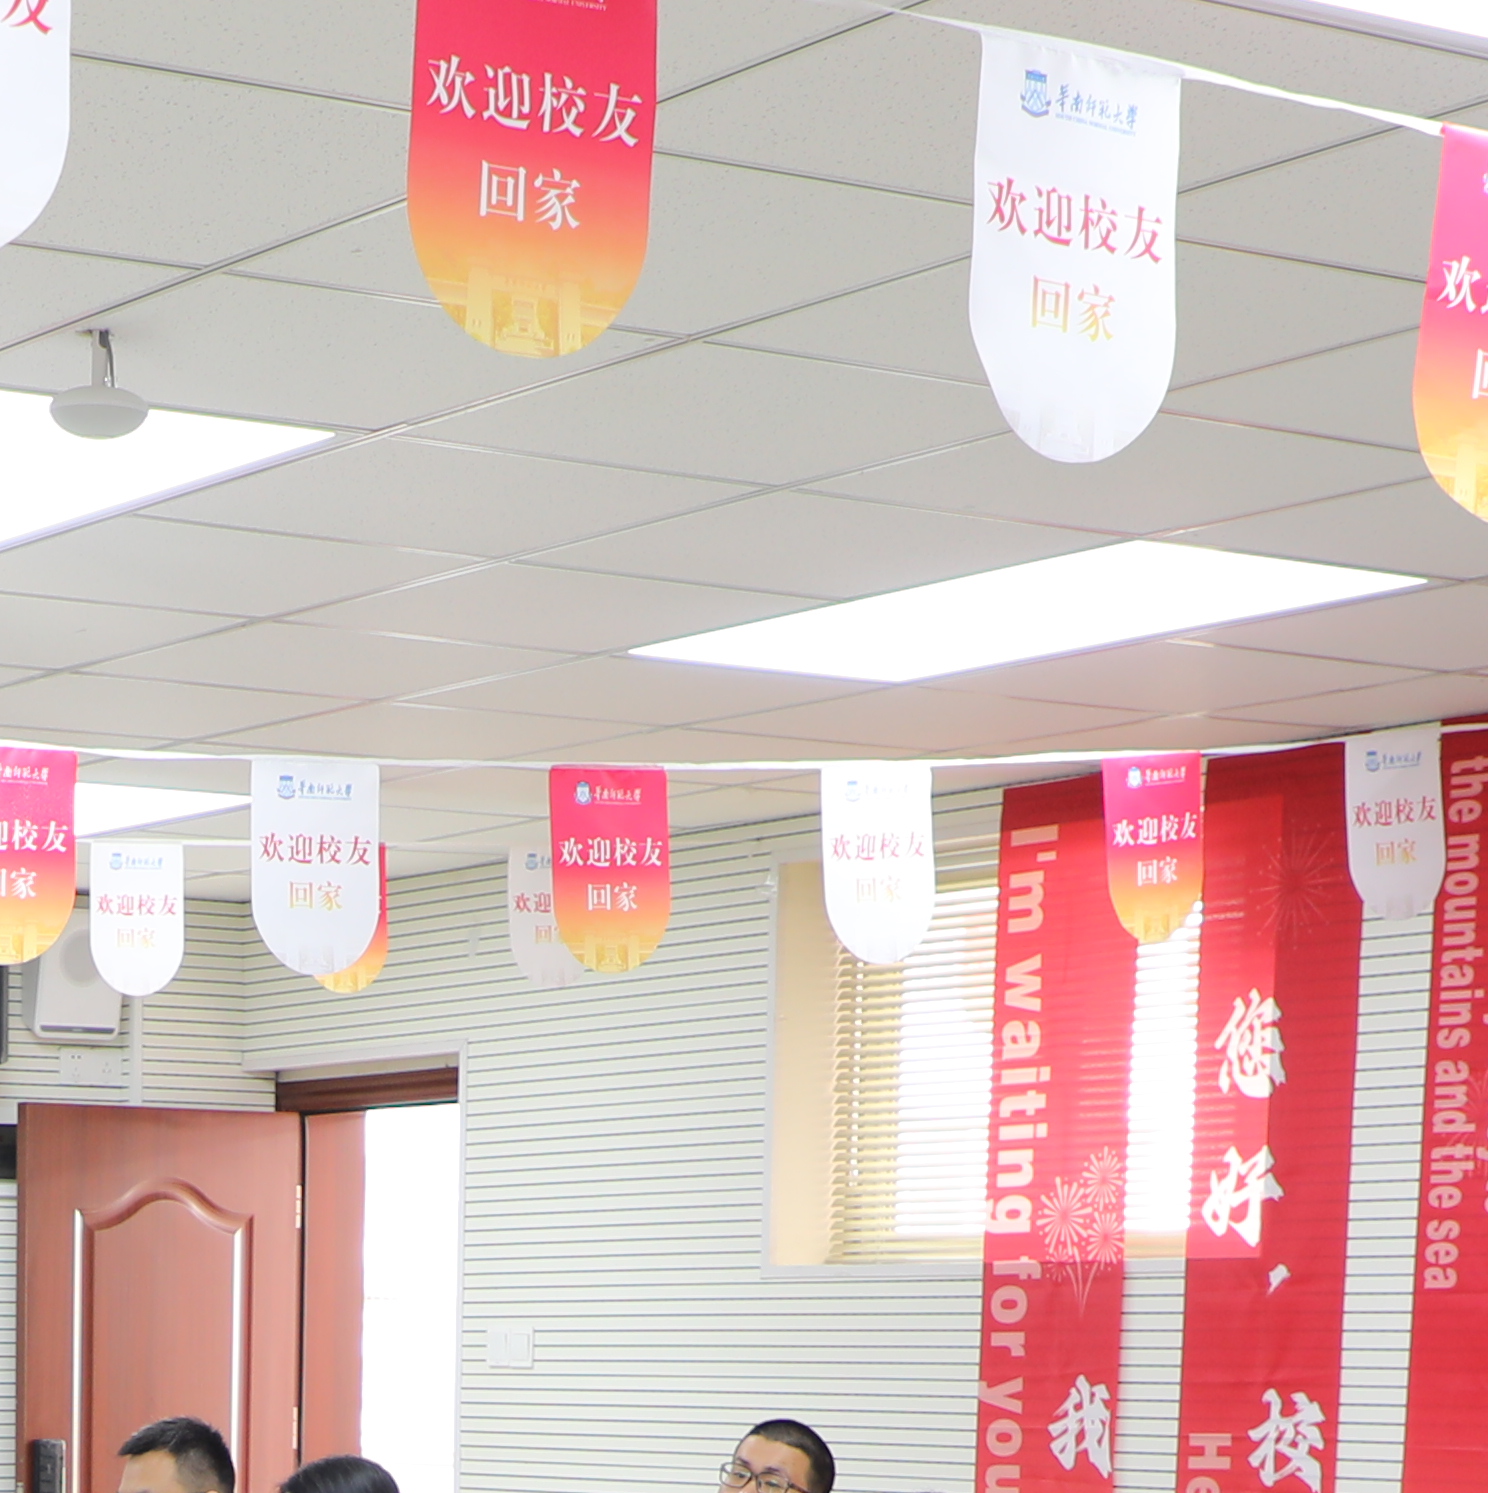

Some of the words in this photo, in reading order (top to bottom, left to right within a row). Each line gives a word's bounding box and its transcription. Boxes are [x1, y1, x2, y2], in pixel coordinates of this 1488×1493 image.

[426, 55, 643, 148] 欢迎校友
[480, 160, 581, 231] 回家
[986, 177, 1163, 264] 欢迎校友
[1031, 274, 1116, 342] 回家
[1111, 812, 1198, 848] 欢迎校友
[1353, 796, 1436, 827] 欢迎校友
[258, 832, 372, 866] 欢迎校友
[558, 836, 663, 868] 欢迎校友
[830, 831, 925, 863] 欢迎校友
[1136, 856, 1178, 886] 回家
[96, 893, 178, 917] 欢迎校友
[288, 880, 343, 912] 回家
[514, 892, 551, 914] 欢迎
[587, 882, 638, 912] 回家
[1436, 833, 1484, 1049] mountains
[983, 954, 1052, 1234] waiting
[1432, 1059, 1476, 1134] and
[1427, 1142, 1474, 1209] the
[1424, 1218, 1461, 1290] sea
[989, 1257, 1042, 1359] for
